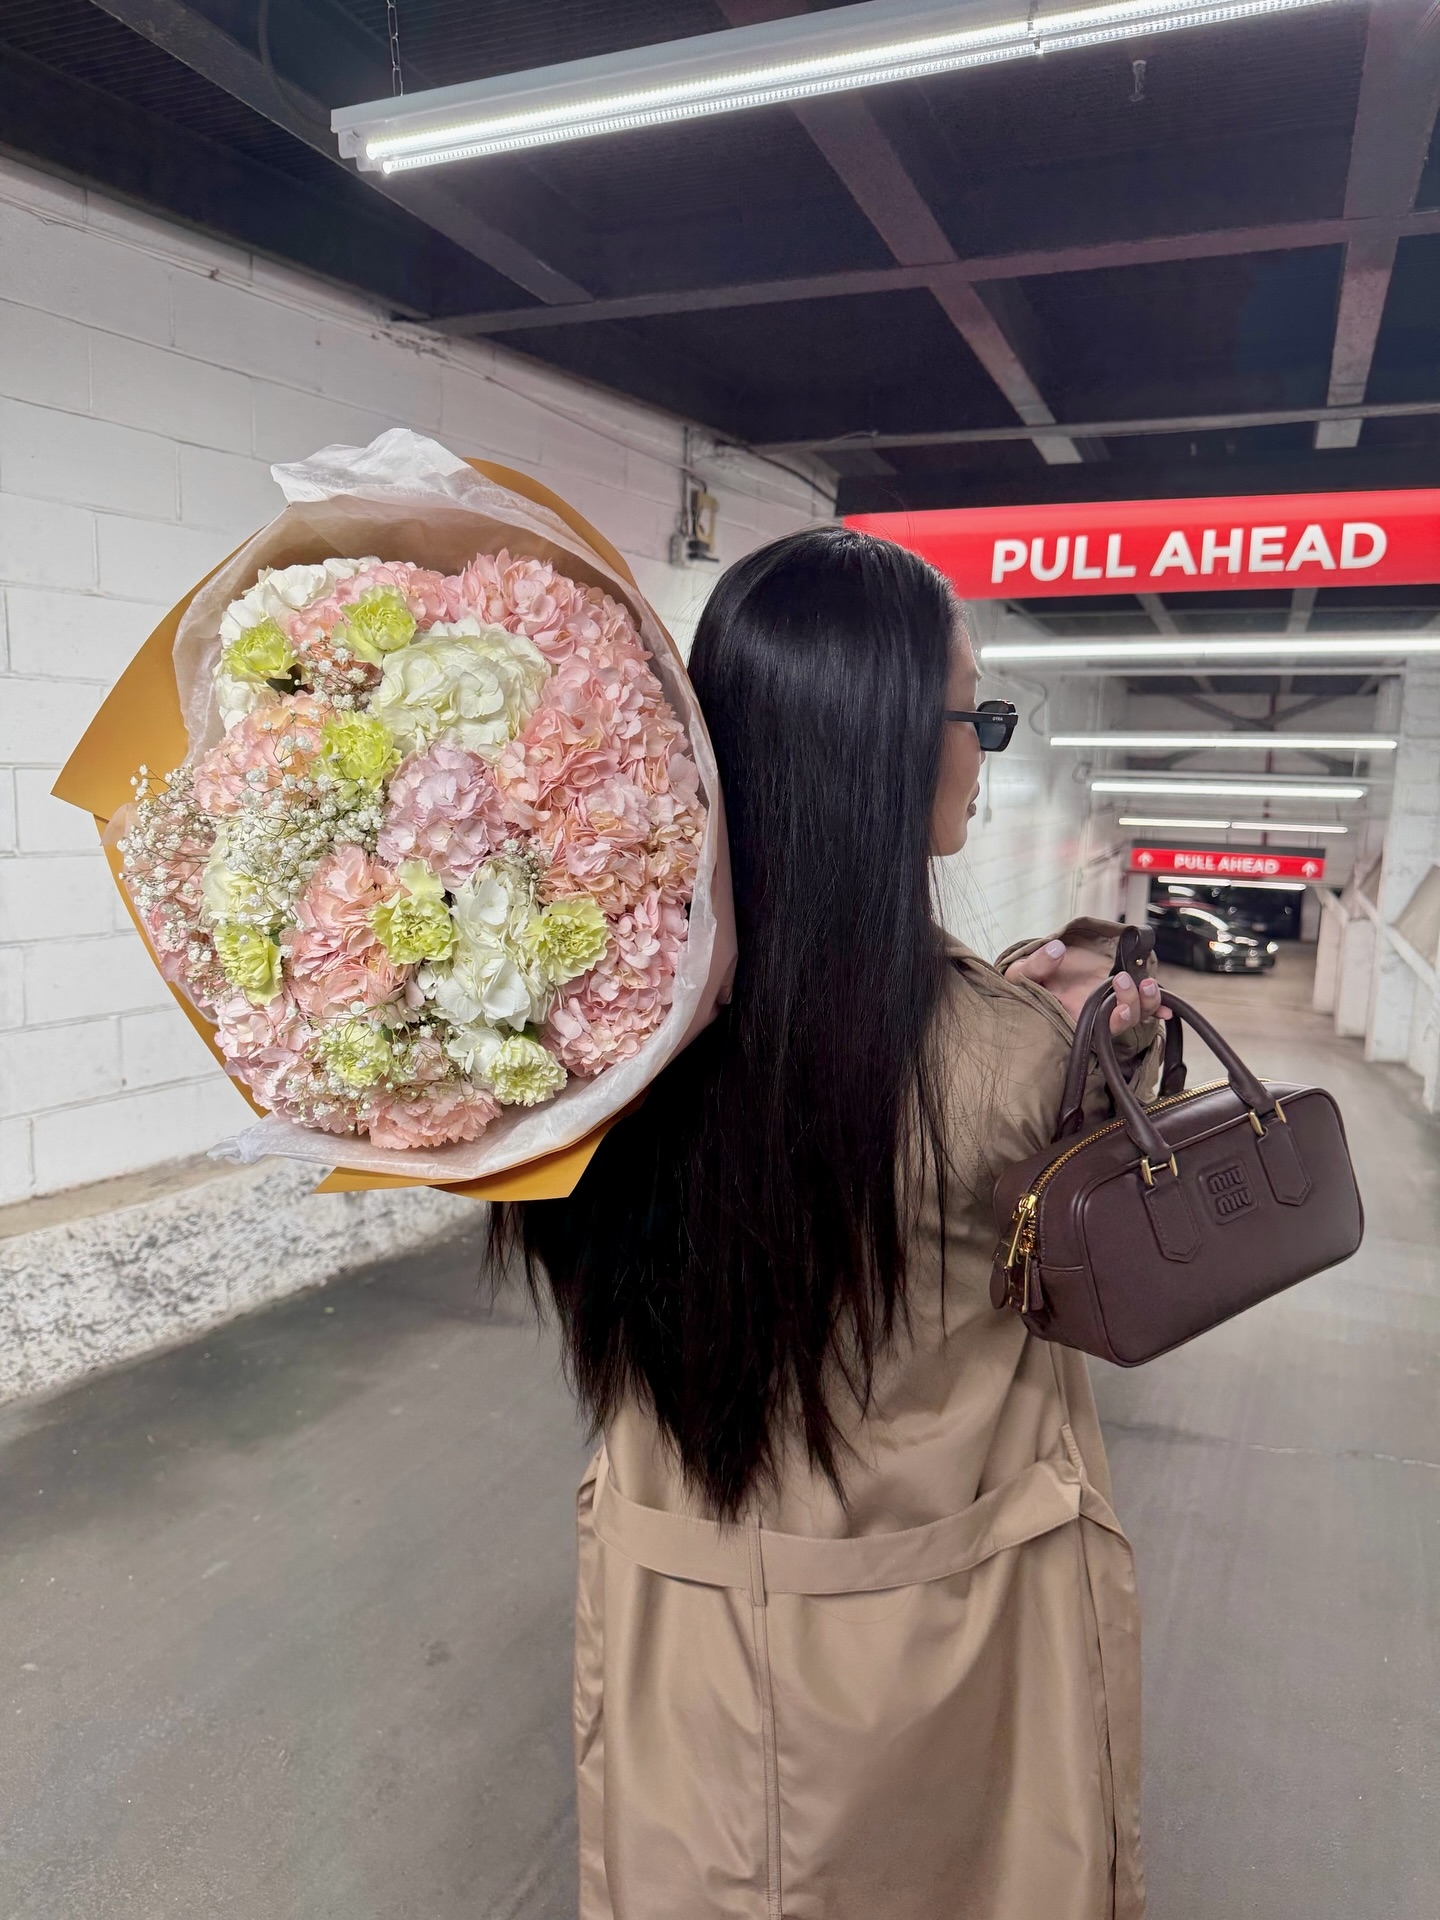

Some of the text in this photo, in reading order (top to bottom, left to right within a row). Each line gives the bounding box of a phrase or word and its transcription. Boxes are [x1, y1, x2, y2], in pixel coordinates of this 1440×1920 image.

[991, 522, 1387, 584] PULL AHEAD
[1174, 853, 1280, 874] PULL AHEAD
